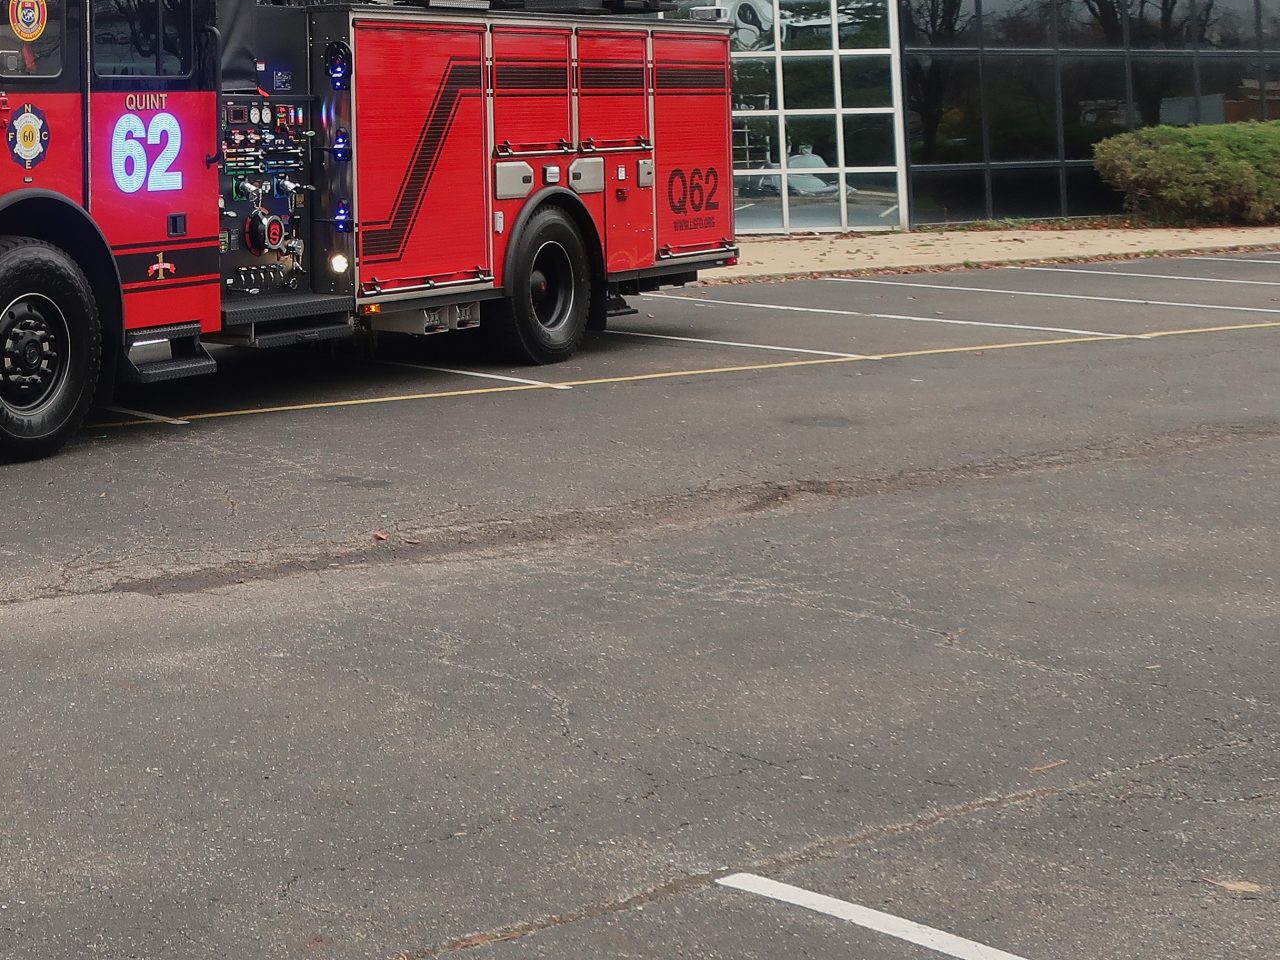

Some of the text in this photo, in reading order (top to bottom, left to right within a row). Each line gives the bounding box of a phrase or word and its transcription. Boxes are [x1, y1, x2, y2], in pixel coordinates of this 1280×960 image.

[24, 103, 32, 113] N
[125, 94, 168, 111] QUINT
[8, 132, 15, 142] F
[23, 130, 34, 143] 60
[41, 131, 48, 140] C
[111, 112, 183, 193] 62
[25, 159, 32, 169] E
[668, 167, 719, 216] Q62
